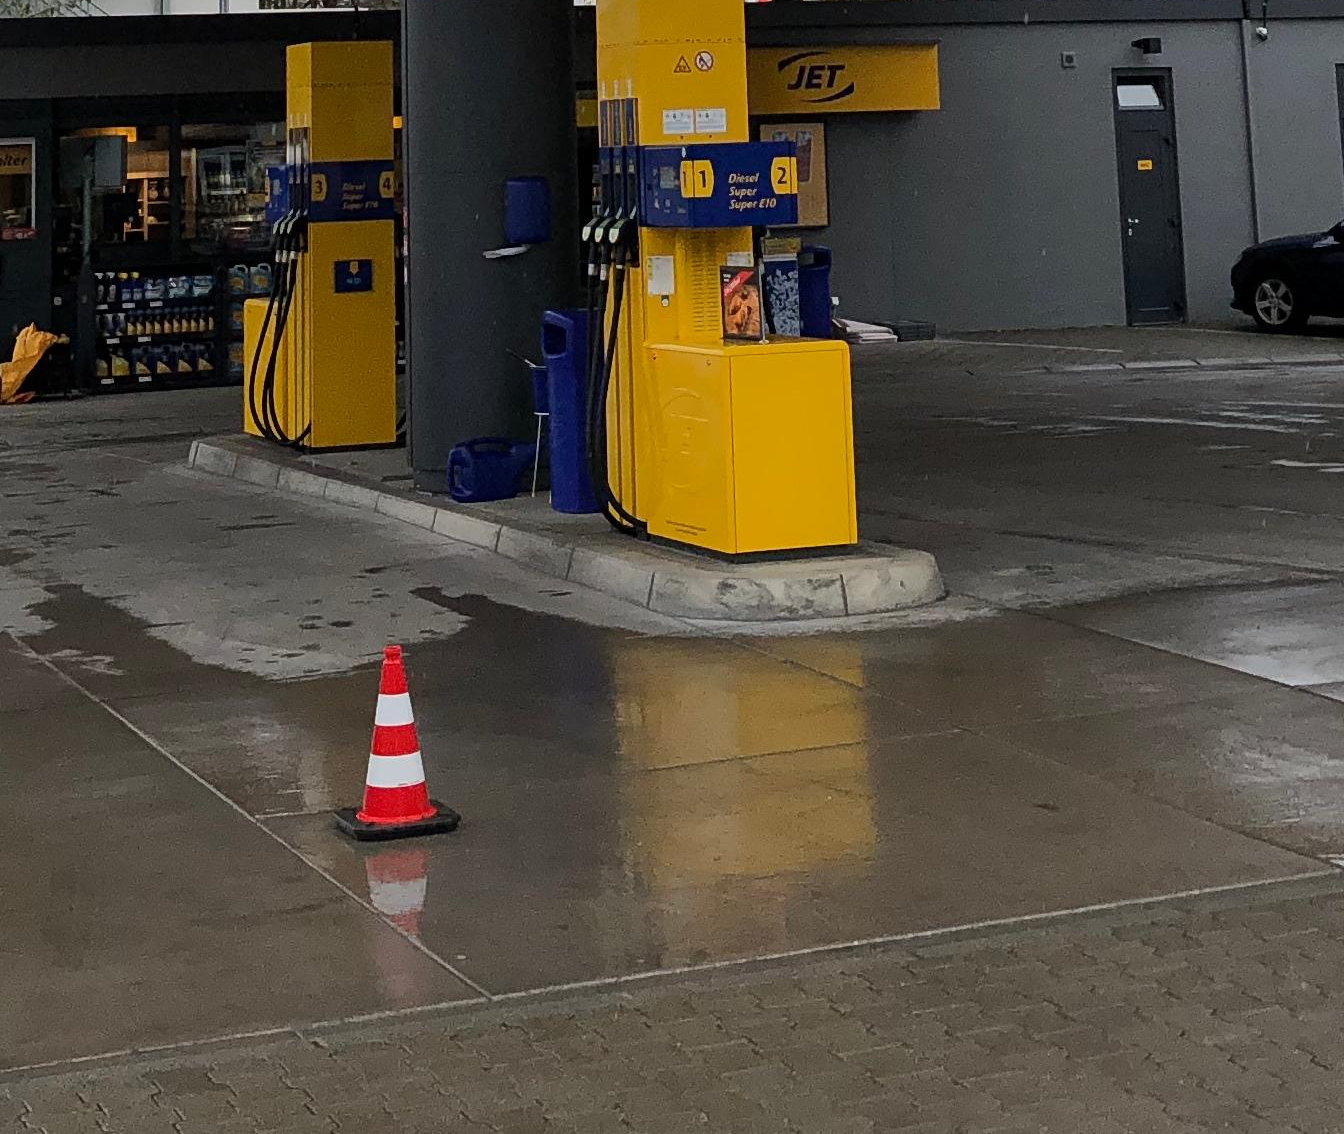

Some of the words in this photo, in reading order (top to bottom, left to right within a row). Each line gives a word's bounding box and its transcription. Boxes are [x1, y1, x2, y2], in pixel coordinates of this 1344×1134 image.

[787, 64, 846, 90] JET
[698, 170, 707, 188] 1
[728, 172, 760, 184] Diesel
[776, 167, 788, 185] 2
[315, 180, 323, 194] 3
[383, 177, 391, 191] 4
[728, 186, 758, 199] Super
[728, 199, 758, 212] Super
[758, 198, 777, 208] E10
